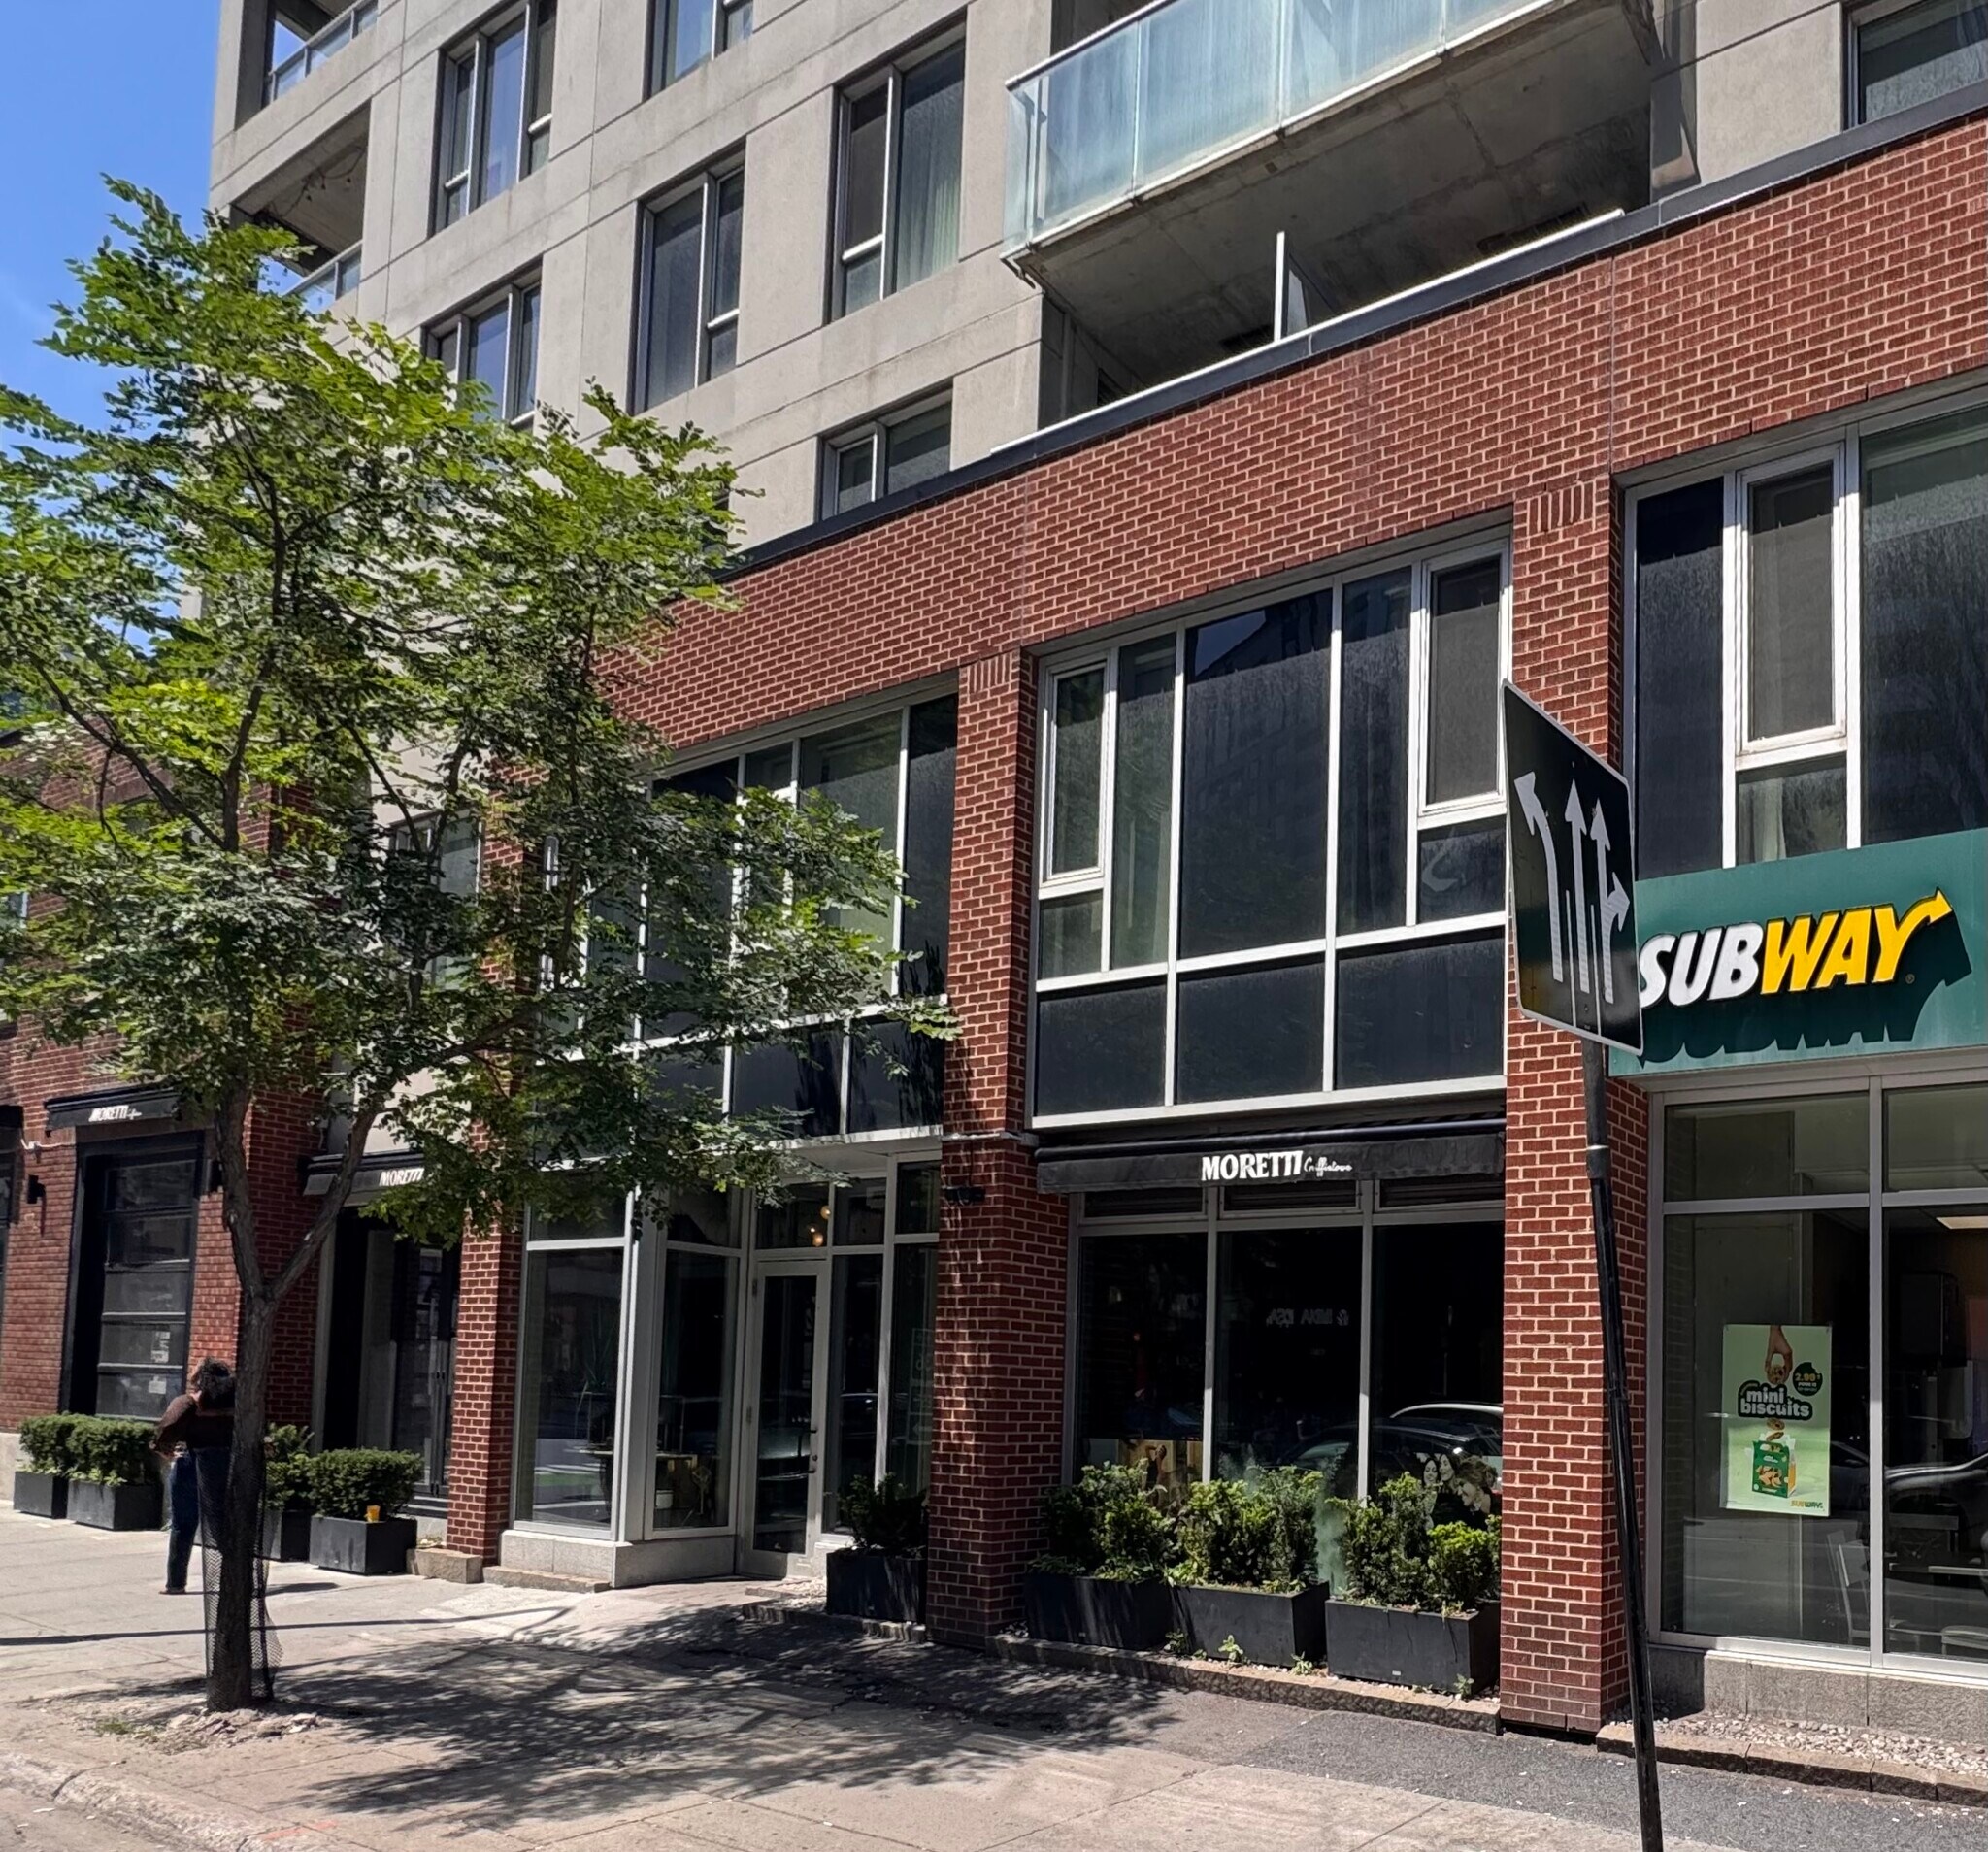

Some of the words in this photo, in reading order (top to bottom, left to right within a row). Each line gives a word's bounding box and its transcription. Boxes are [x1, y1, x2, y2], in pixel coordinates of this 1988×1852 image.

[1640, 887, 1953, 1008] SUBWAY
[88, 1105, 129, 1122] MORETTI
[1201, 1150, 1304, 1181] MORETTI
[379, 1167, 424, 1186] MORETTI
[1746, 1386, 1784, 1404] mini
[1740, 1398, 1809, 1417] biscuits
